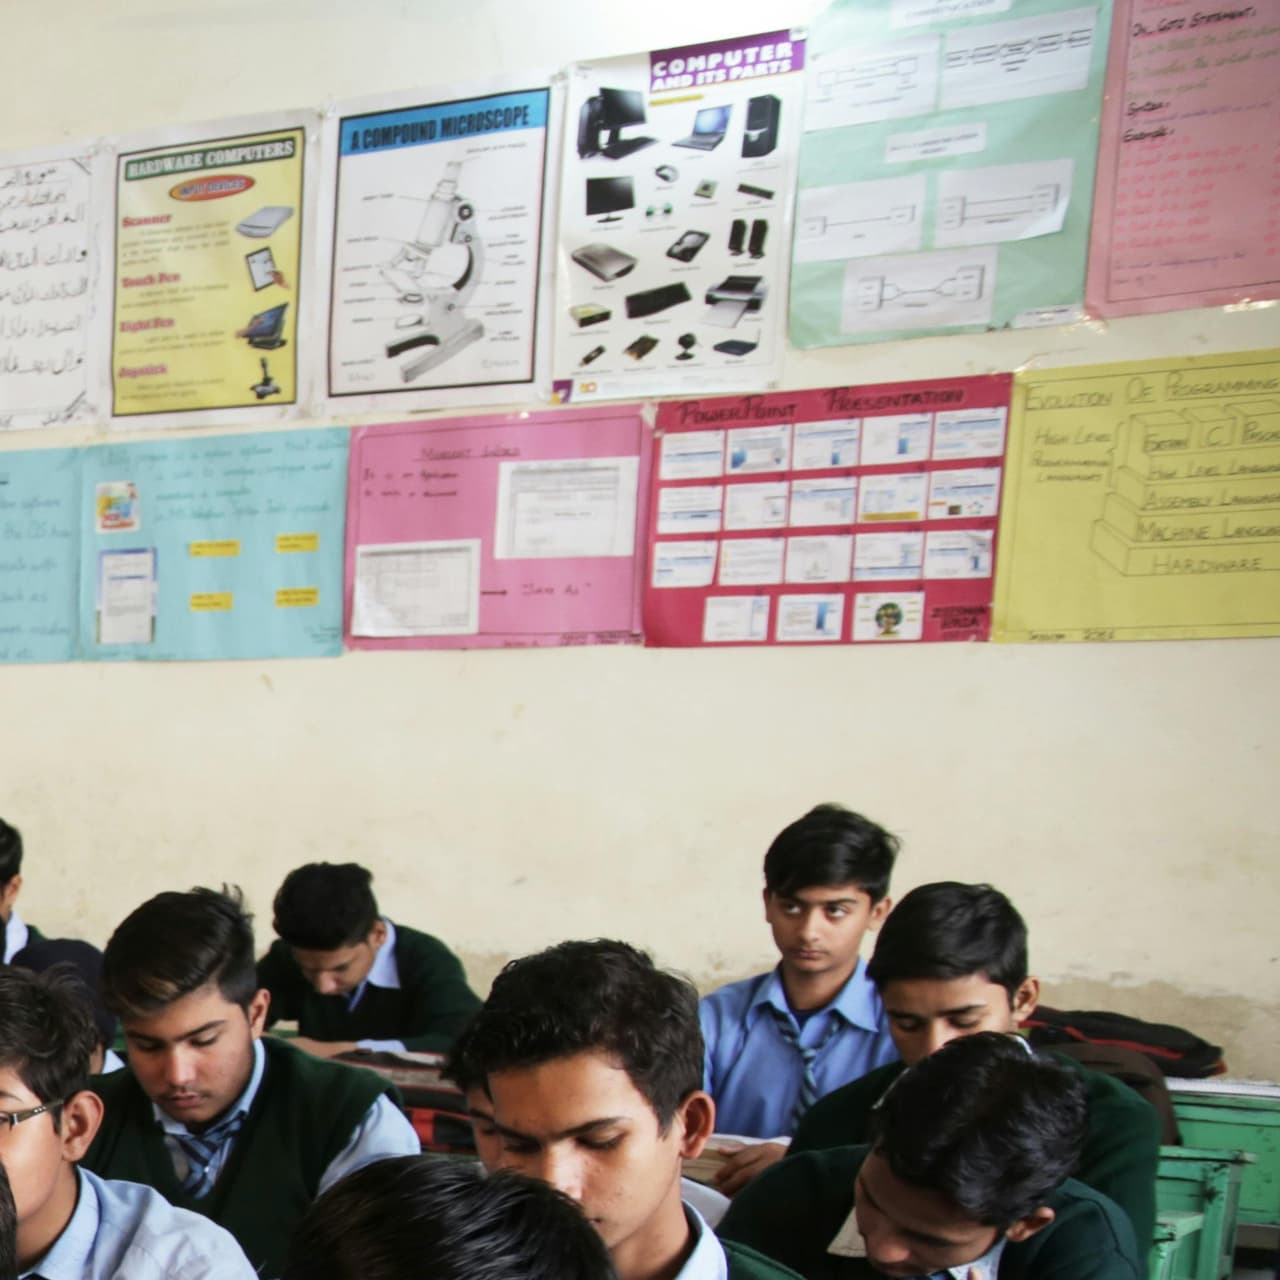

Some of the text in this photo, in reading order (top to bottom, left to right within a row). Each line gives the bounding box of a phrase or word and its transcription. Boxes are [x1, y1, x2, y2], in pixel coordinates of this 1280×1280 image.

[652, 40, 794, 78] COMPUTER
[651, 58, 794, 93] AND ITS PARTS
[349, 104, 531, 152] A COMPOUND MICROSCOPE
[126, 137, 296, 180] HARDWARE COMPUTERS
[122, 213, 173, 229] Scanner
[157, 271, 182, 285] Pen
[150, 315, 176, 330] Pen
[820, 385, 966, 413] PRESENTATION
[1025, 384, 1114, 411] EVOLUTION
[1206, 426, 1225, 447] C
[1151, 553, 1265, 575] HARDWARE
